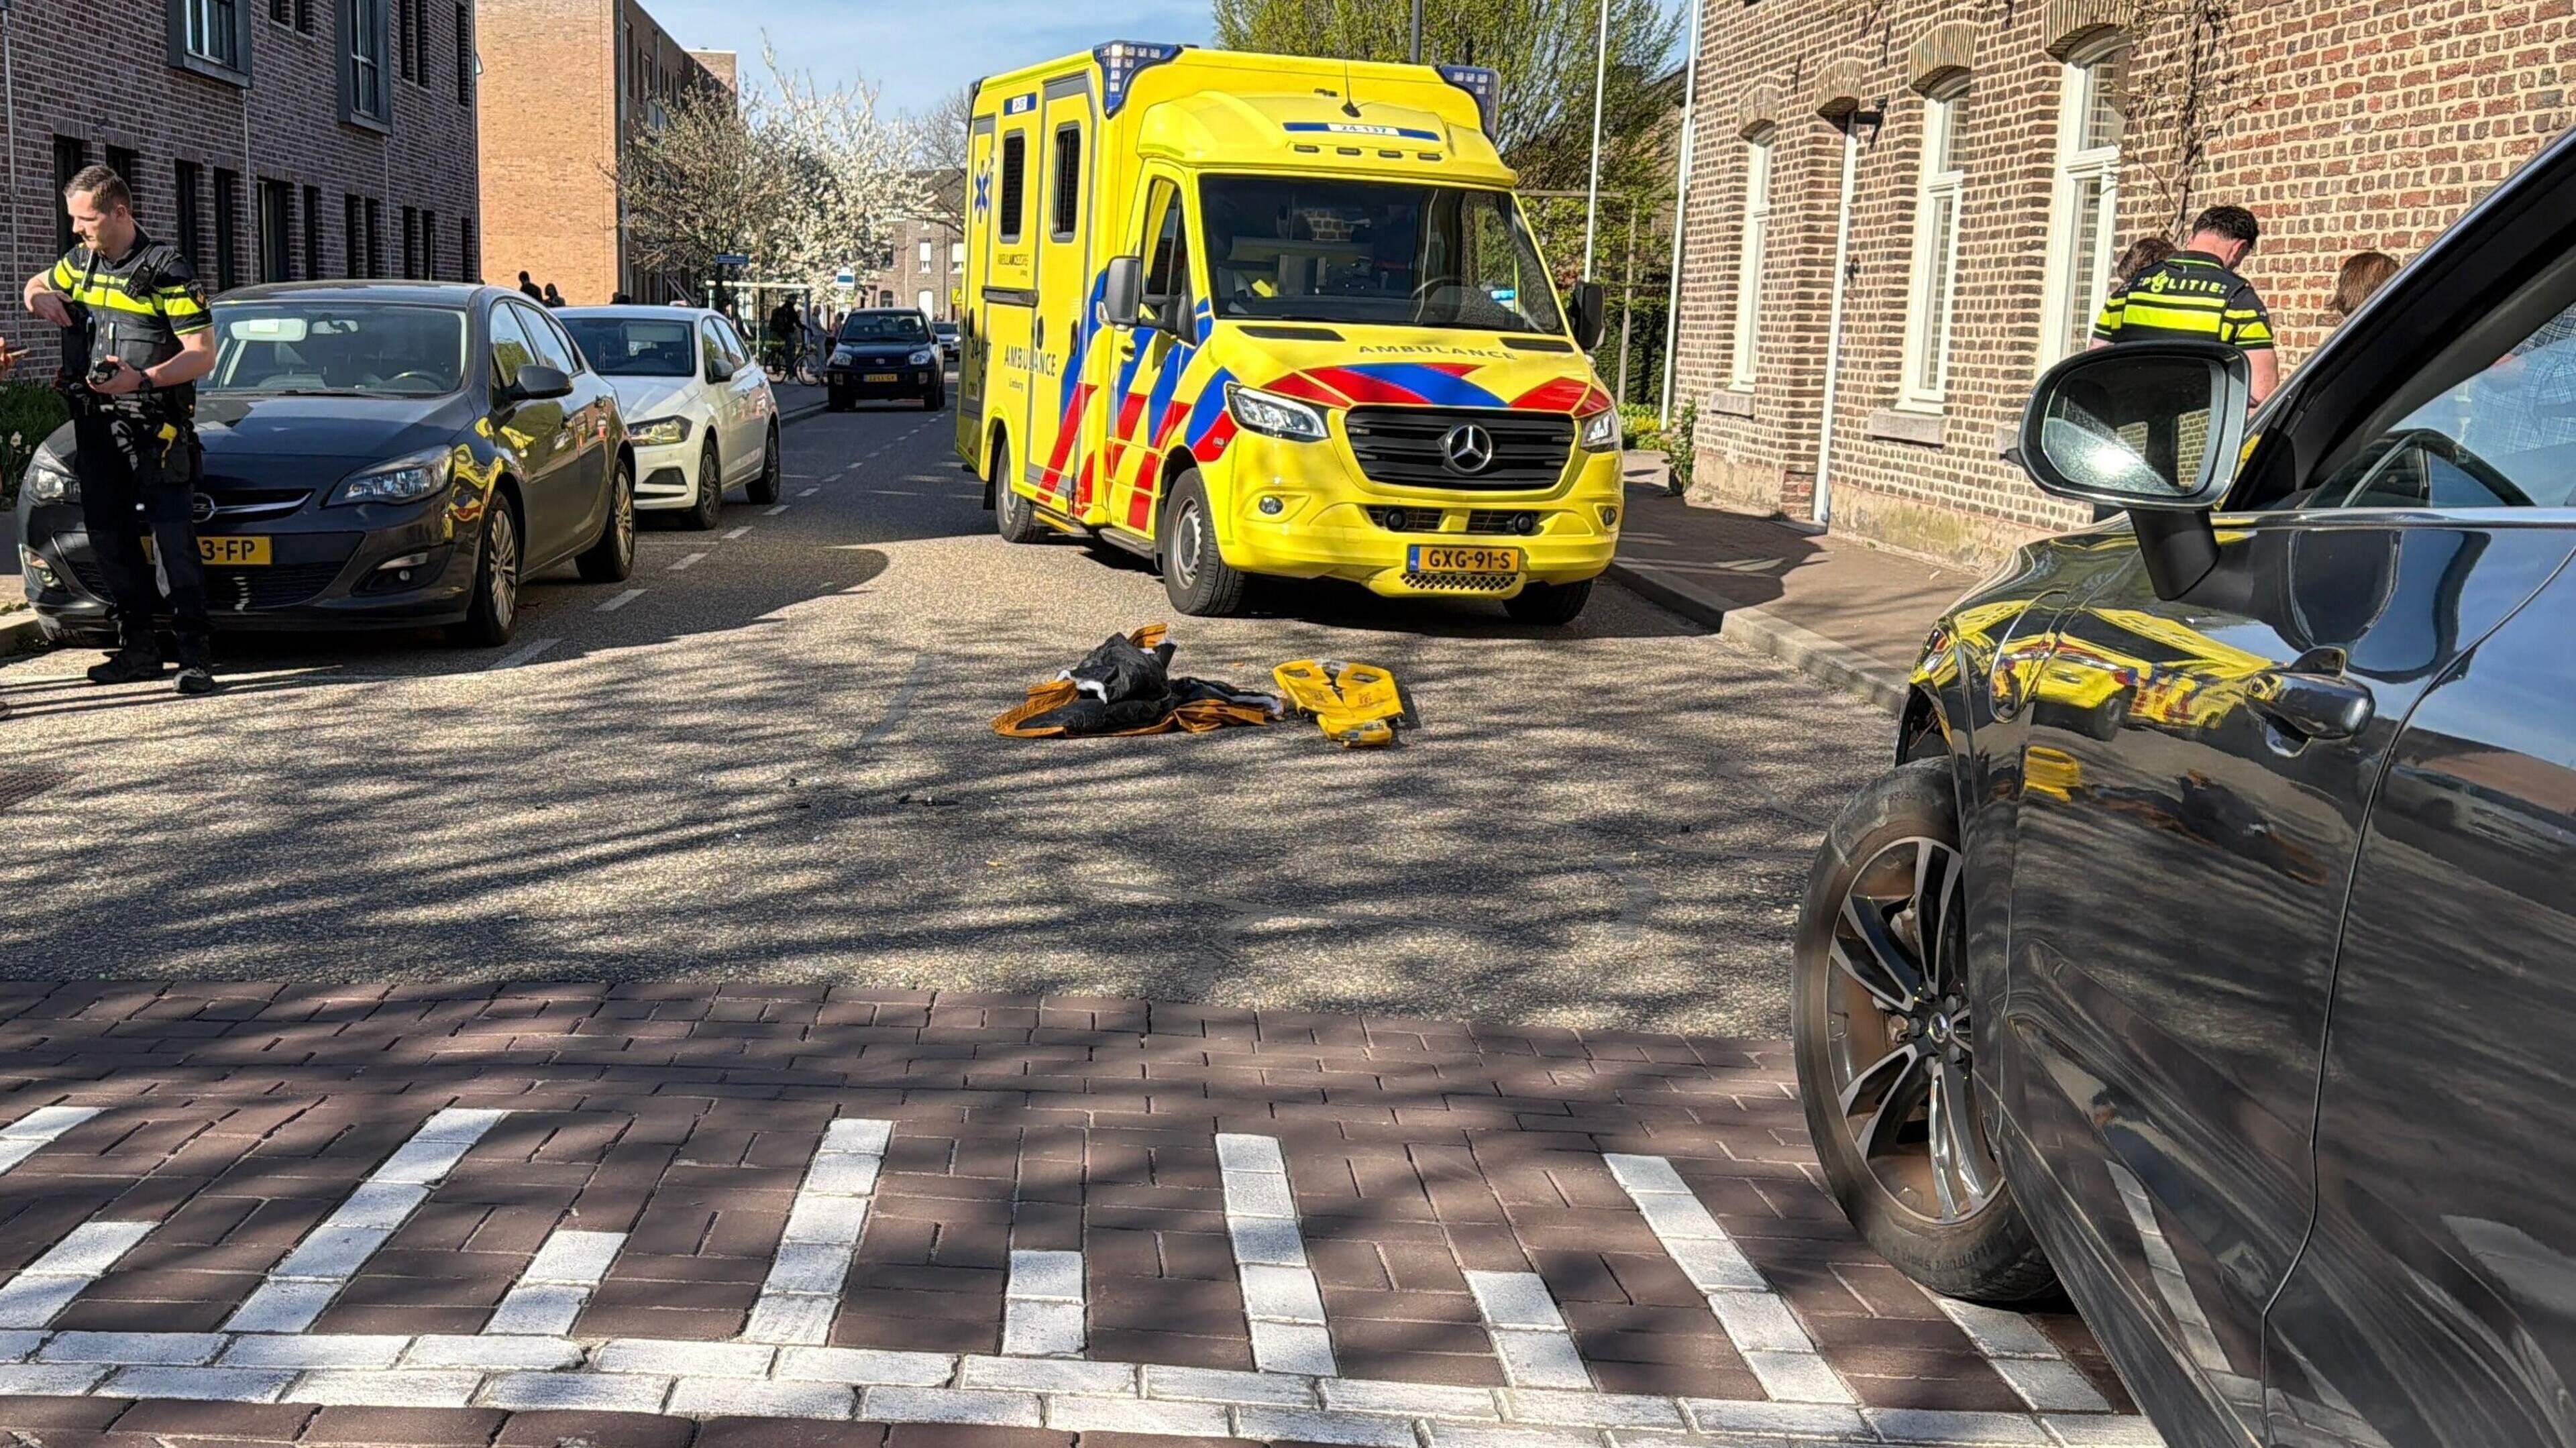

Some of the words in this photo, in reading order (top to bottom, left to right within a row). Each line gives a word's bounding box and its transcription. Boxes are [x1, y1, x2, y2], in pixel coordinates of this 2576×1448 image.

[1004, 345, 1057, 377] AMBULANCE
[1359, 345, 1518, 360] AMBULANCE
[1428, 549, 1511, 569] GXG-91-S
